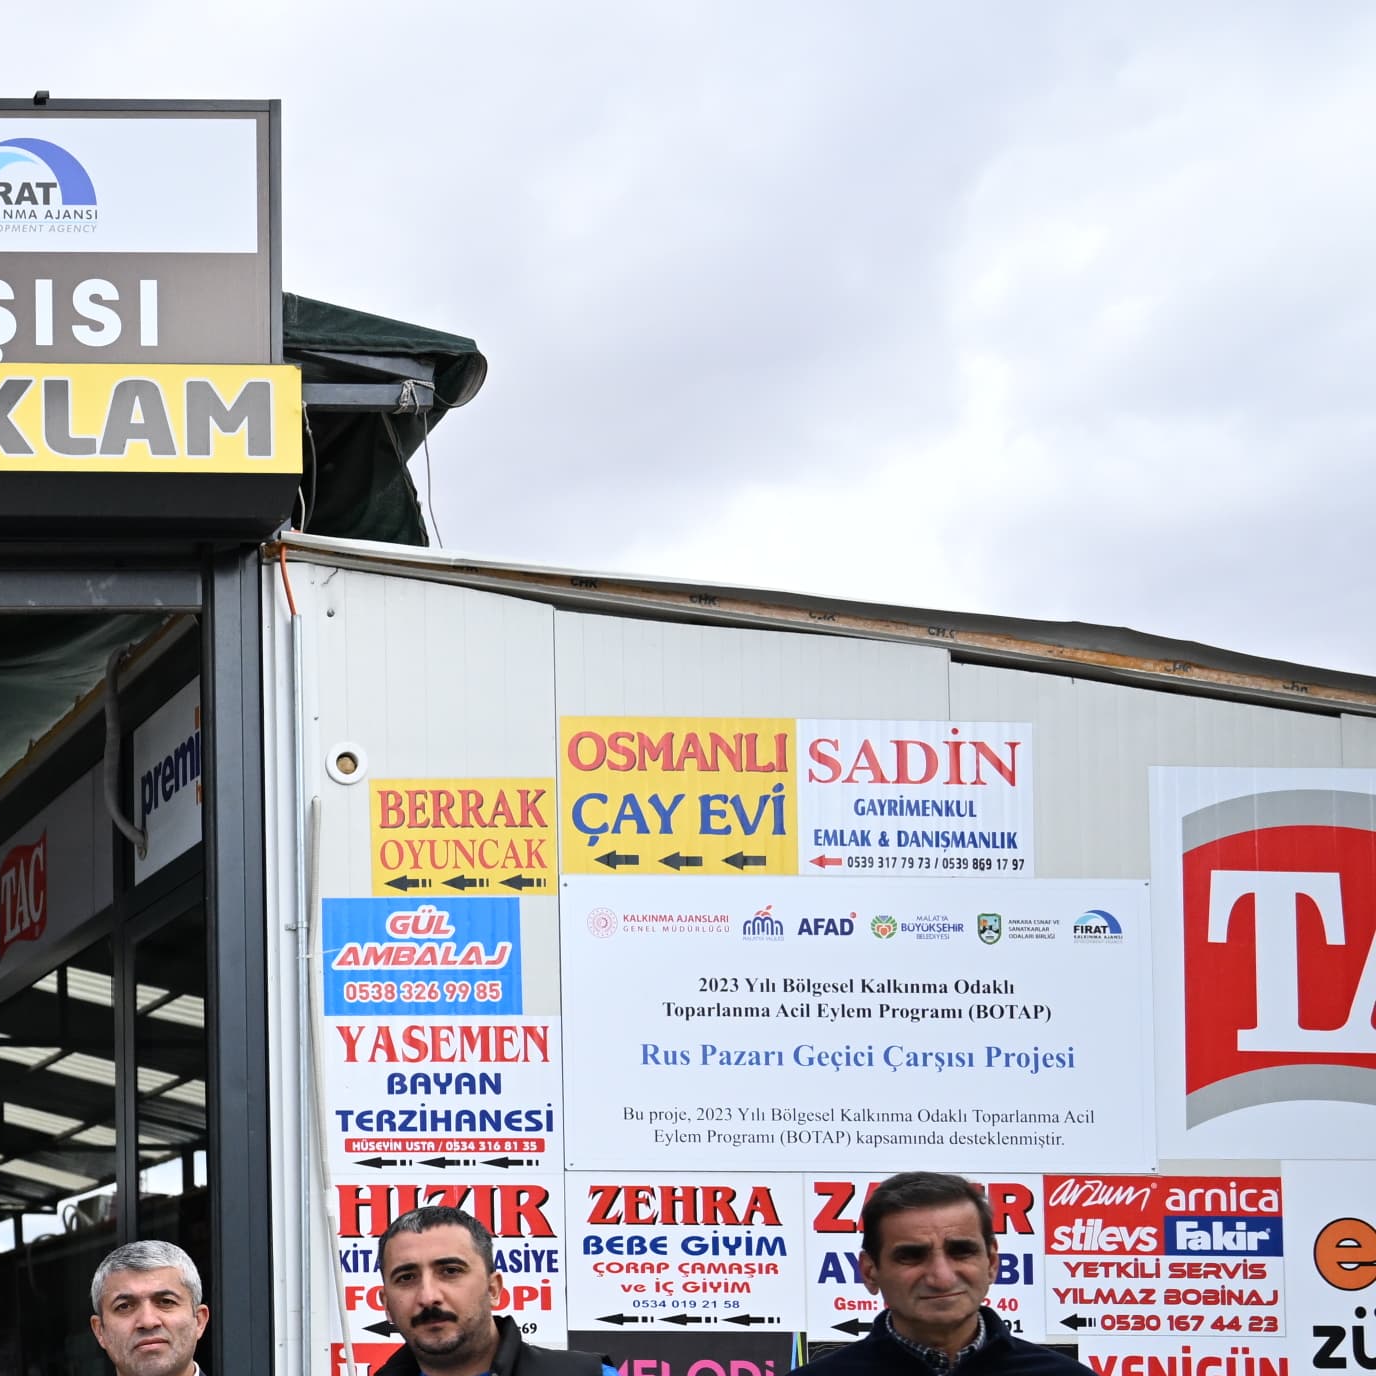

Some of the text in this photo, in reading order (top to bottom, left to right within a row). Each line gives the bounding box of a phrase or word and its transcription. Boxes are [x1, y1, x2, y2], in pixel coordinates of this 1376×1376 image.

[44, 209, 98, 221] AJANSI
[567, 730, 789, 774] OSMANLI
[807, 727, 1022, 788] SADİN
[379, 789, 547, 829] BERRAK
[571, 783, 787, 847] ÇAY EVİ
[853, 795, 977, 820] GAYRİMENKUL
[813, 829, 1018, 852] EMLAK DANIŞMANLIK
[379, 838, 547, 871] OYUNCAK
[387, 907, 454, 936] GÜL
[798, 918, 853, 936] AFAD
[335, 945, 509, 967] AMBALAJ
[345, 982, 502, 1001] 0538 326 99 85
[698, 976, 1014, 999] 2023 Yılı Bölgesel Kalkınma Odaklı
[662, 1002, 1052, 1024] Toparlanma Acil Eylem Programı (BOTAP)
[335, 1025, 551, 1063] YASEMEN
[639, 1043, 1075, 1074] Rus Pazarı Geçici Çarşısı Projesi
[386, 1072, 502, 1095] BAYAN
[335, 1103, 554, 1133] TERZİHANESİ
[623, 1107, 1095, 1128] Bu proje, 2023 Yılı Bölgesel Kalkınma Odaklı Toparlanma Acil
[352, 1139, 435, 1152] HÜSEYİN USTA
[653, 1129, 1066, 1150] Eylem Programı (BOTAP) kapsamında desteklenmiştir.
[586, 1185, 783, 1226] ZEHRA
[1048, 1178, 1278, 1212] arzum arnica
[582, 1229, 787, 1257] BEBE GİYİM
[1051, 1217, 1266, 1253] stilevs Fakir
[593, 1262, 779, 1278] ÇORAP ÇAMAŞIR
[1063, 1256, 1267, 1280] YETKİLİ SERVİS
[620, 1278, 751, 1297] ve İÇ GİYİM
[1053, 1284, 1279, 1307] YILMAZ BOBİNAJ
[1100, 1314, 1279, 1332] 0530 167 44 23
